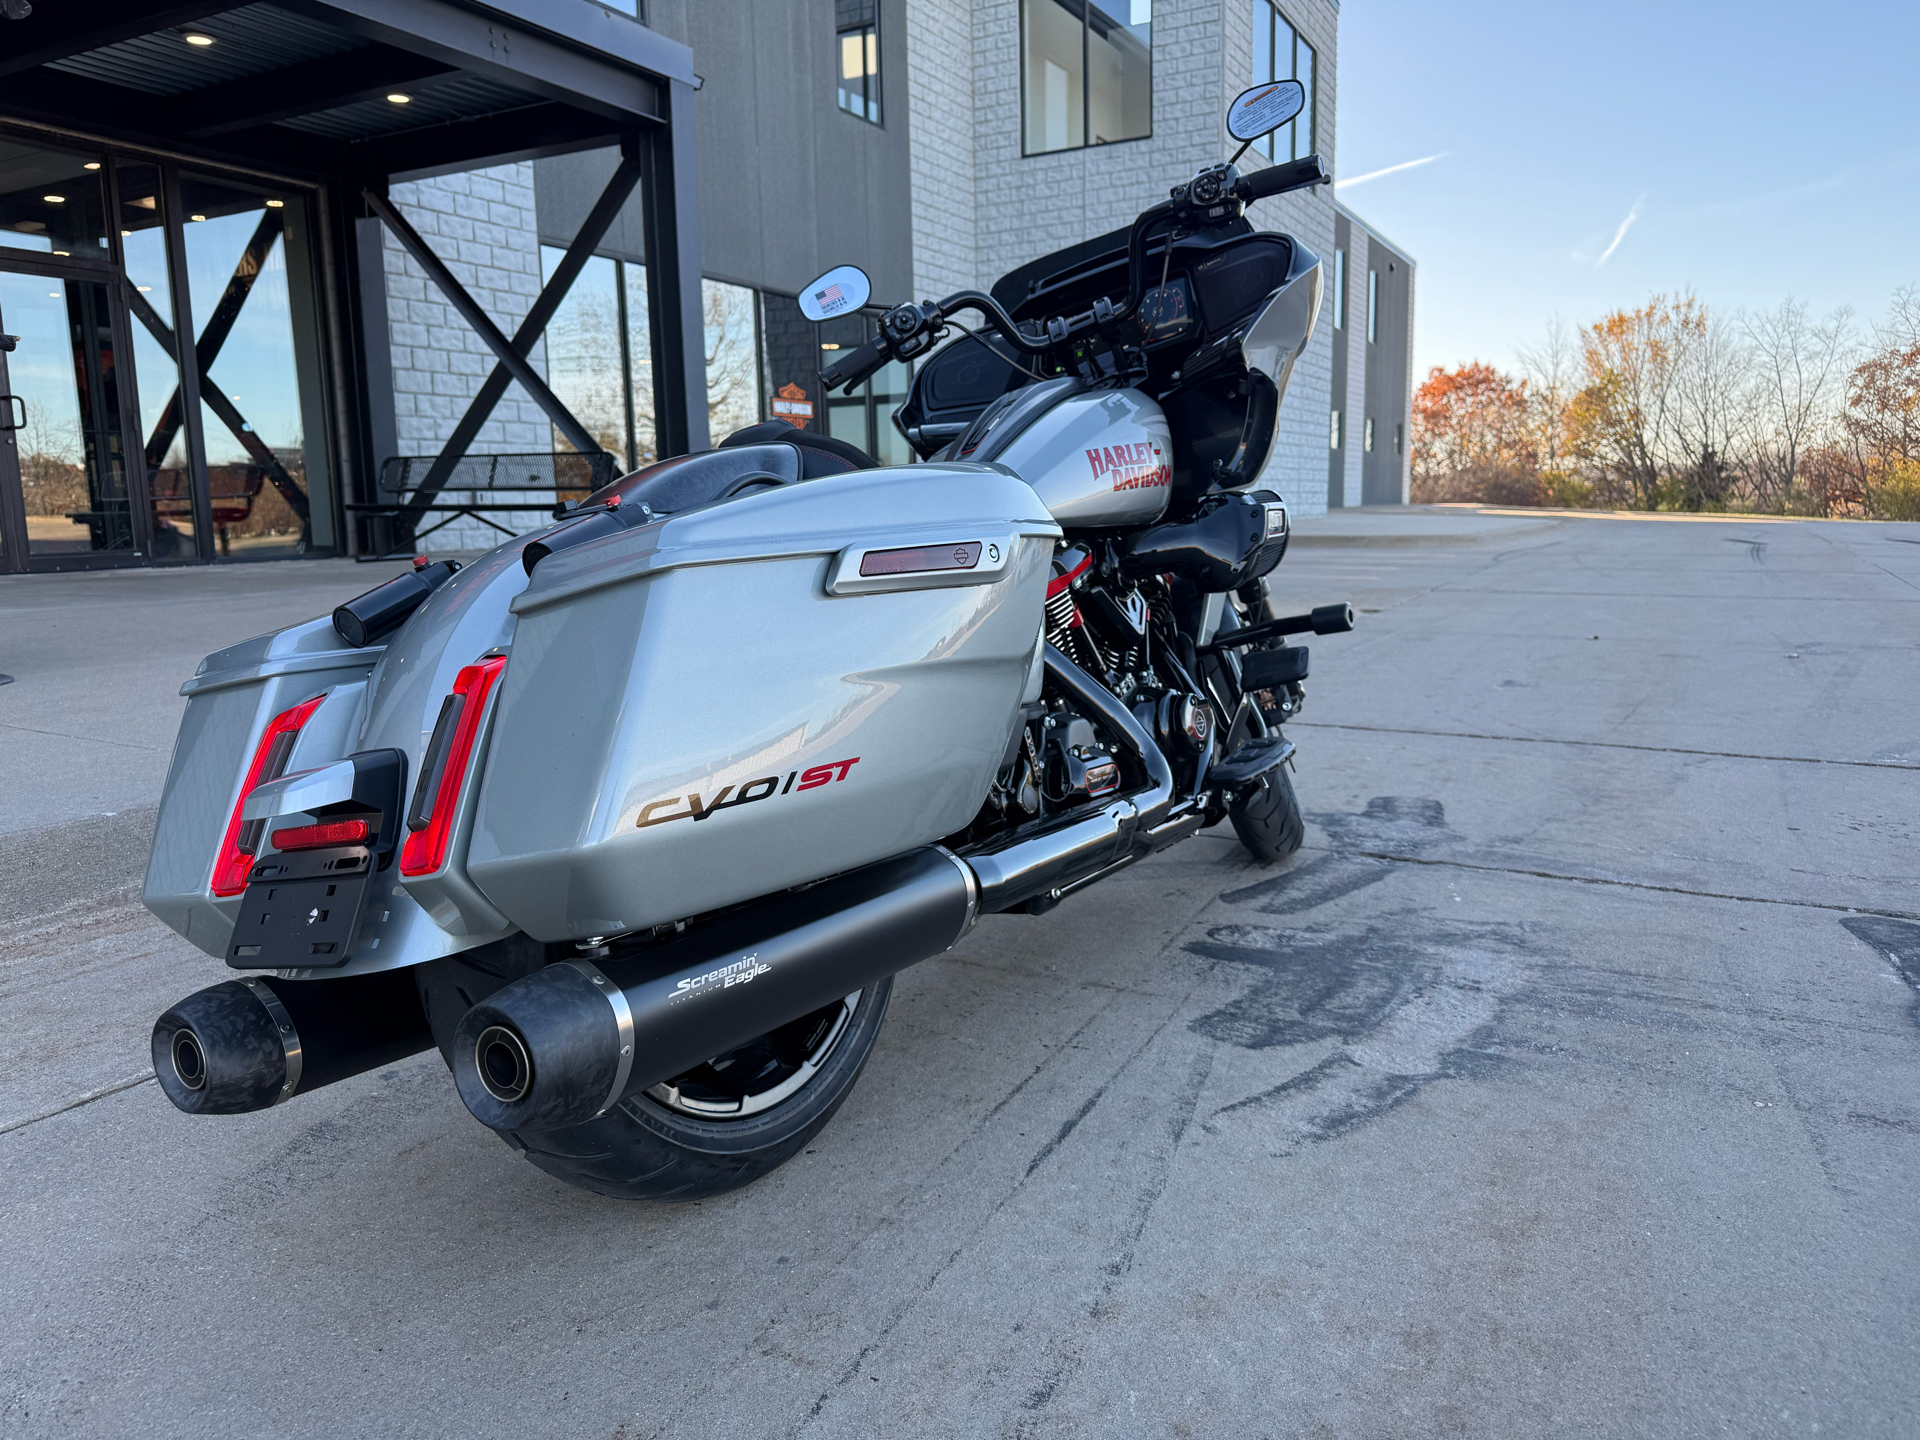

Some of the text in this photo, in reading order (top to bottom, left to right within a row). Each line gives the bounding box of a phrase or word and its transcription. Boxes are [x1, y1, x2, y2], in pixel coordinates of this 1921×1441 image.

[1085, 442, 1161, 481] HARLEY-
[1111, 465, 1172, 492] DAVIDSON
[796, 756, 861, 792] ST
[668, 952, 758, 998] Screamin'
[724, 963, 772, 988] Eagle
